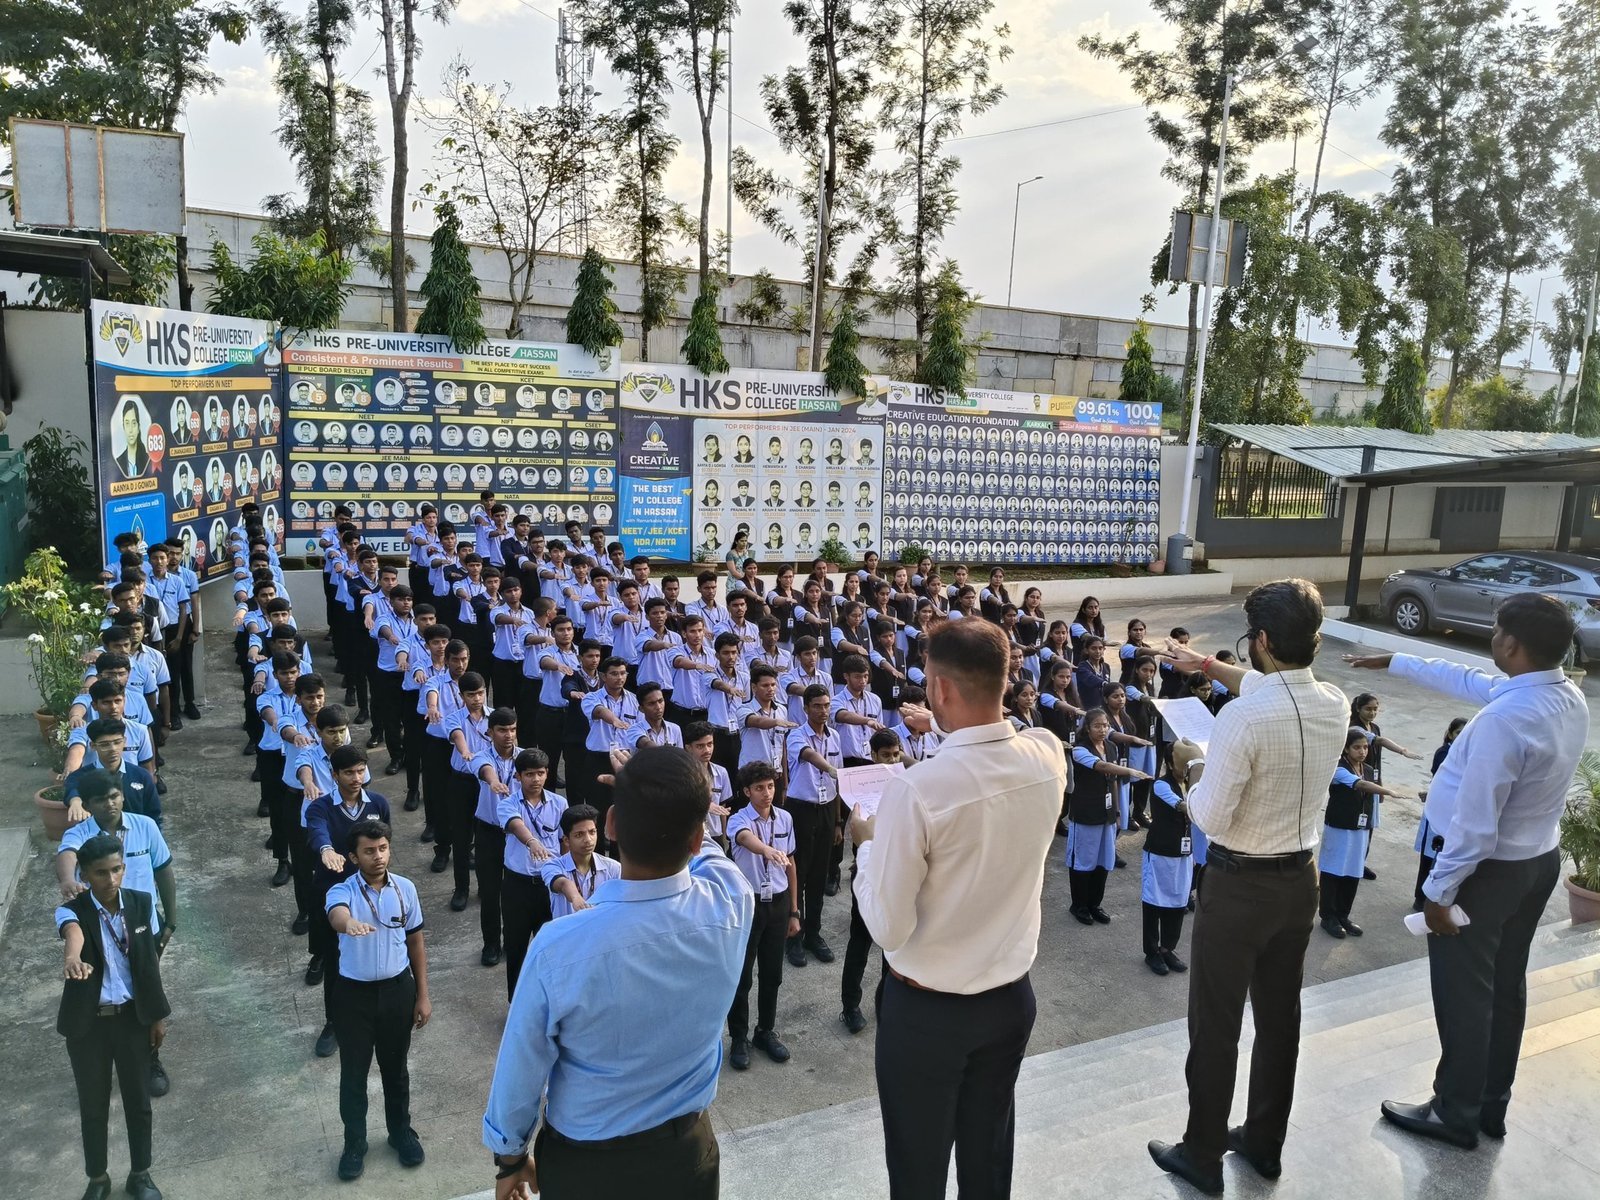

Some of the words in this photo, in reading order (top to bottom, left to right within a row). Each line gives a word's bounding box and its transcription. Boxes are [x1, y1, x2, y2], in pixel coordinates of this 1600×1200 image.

[146, 320, 191, 366] HKS
[193, 325, 253, 345] PRE-UNIVERSITY
[194, 347, 228, 363] COLLEGE
[230, 350, 253, 363] HASSAN
[313, 335, 340, 348] HKS
[347, 337, 454, 354] PRE-UNIVERSITY
[521, 349, 557, 360] HASSAN
[291, 352, 348, 364] Consistent
[350, 355, 359, 364] &
[362, 356, 414, 367] Prominent
[416, 359, 454, 368] Results
[170, 380, 181, 388] TOP
[182, 380, 216, 388] PERFORMERS
[222, 380, 233, 388] NEET
[745, 382, 838, 398] PRE-UNIVERSITY
[680, 378, 741, 410] HKS
[915, 386, 945, 405] HKS
[745, 397, 797, 410] COLLEGE
[801, 400, 838, 410] HASSAN
[1050, 402, 1060, 410] PU
[1078, 400, 1120, 416] 99.61%
[1124, 404, 1160, 420] 100%
[927, 413, 970, 424] EDUCATION
[972, 416, 1019, 427] FOUNDATION
[148, 434, 164, 452] 683
[632, 484, 649, 493] THE
[652, 484, 674, 493] BEST
[646, 496, 682, 504] COLLEGE
[644, 508, 677, 516] HASSAN
